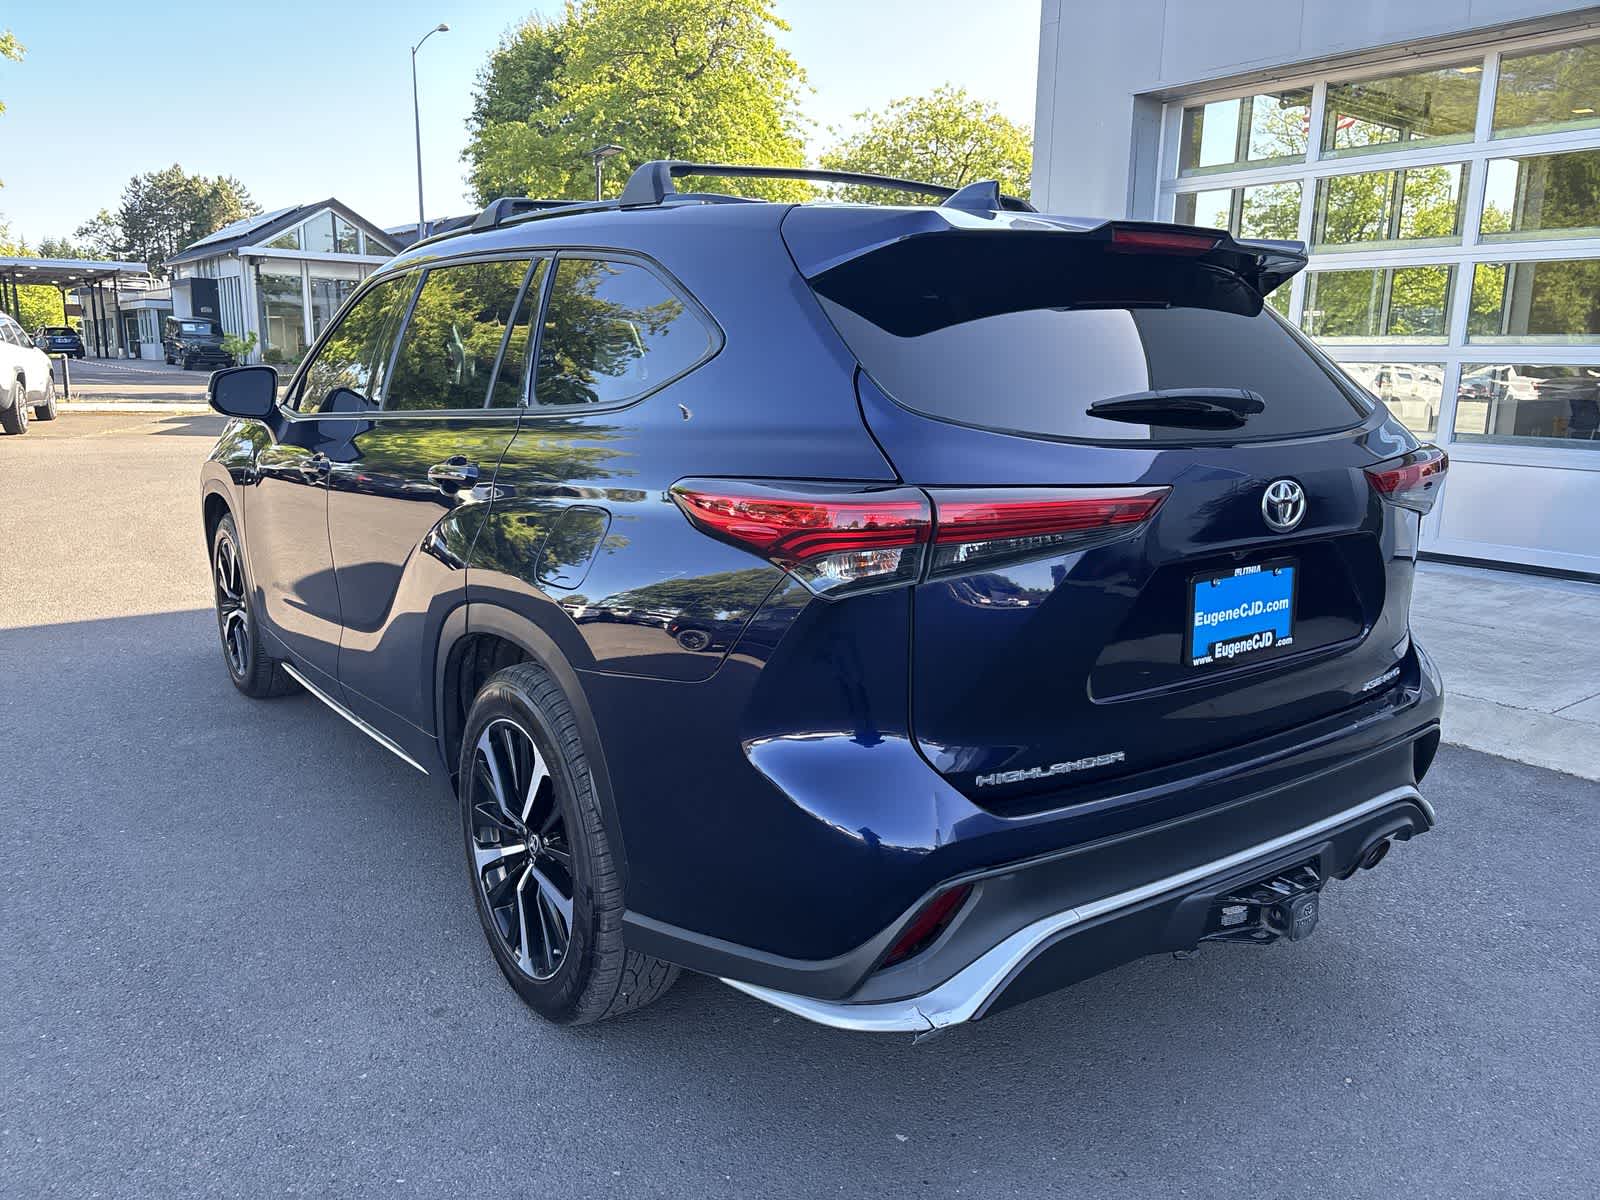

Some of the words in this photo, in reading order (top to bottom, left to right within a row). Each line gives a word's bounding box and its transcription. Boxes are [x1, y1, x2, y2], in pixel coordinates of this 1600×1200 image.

[1194, 598, 1289, 627] EugeneCJD.com
[1192, 655, 1213, 667] www.
[1215, 631, 1273, 658] EugeneCJD
[1275, 637, 1293, 647] .com
[975, 751, 1126, 788] HIGHLANDER
